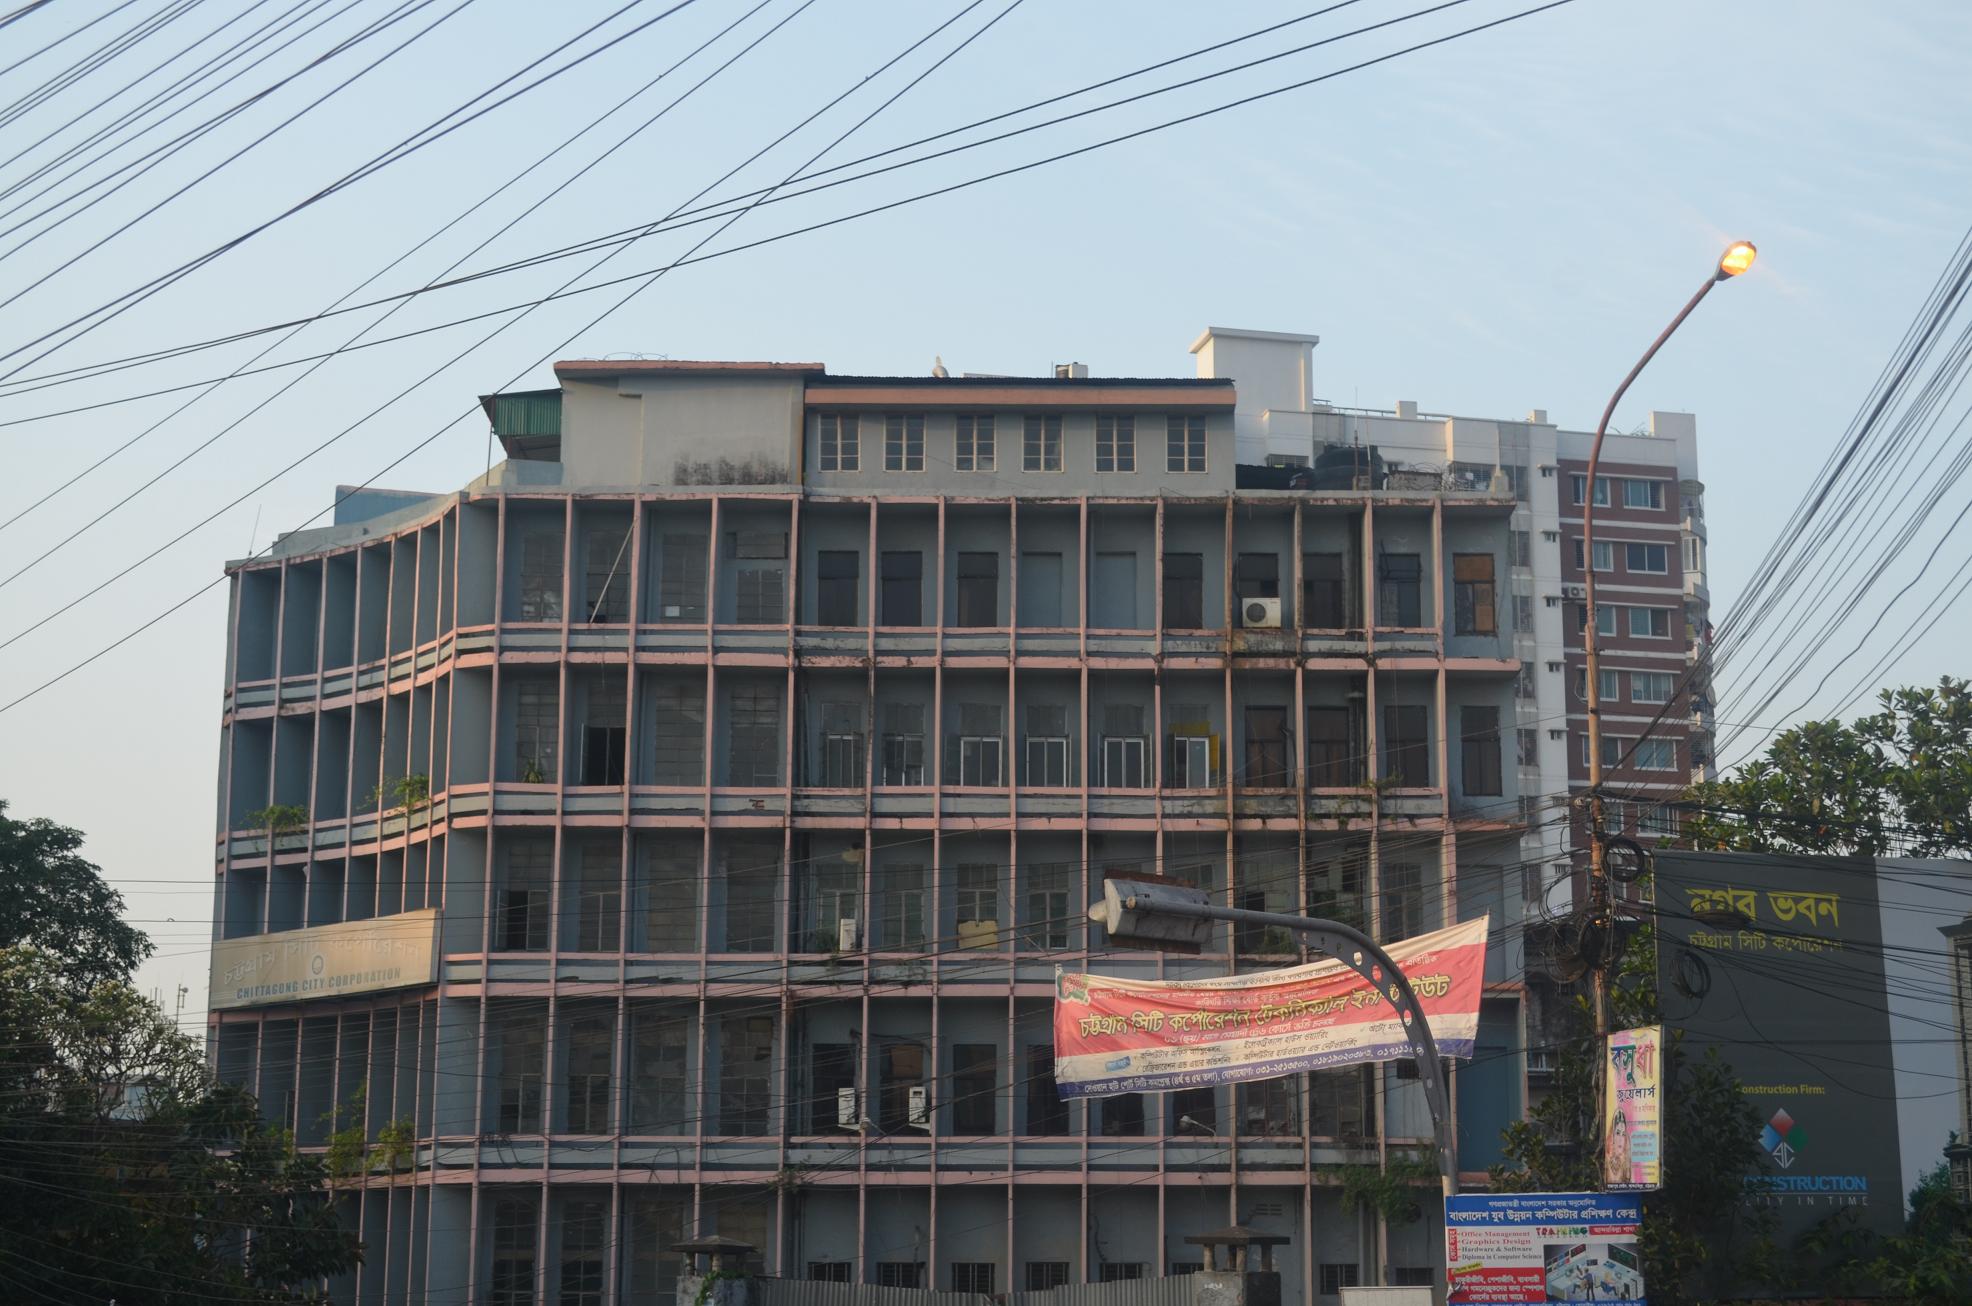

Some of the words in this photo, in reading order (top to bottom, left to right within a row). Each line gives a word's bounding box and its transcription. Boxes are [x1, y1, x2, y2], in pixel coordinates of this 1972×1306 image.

[1767, 891, 1841, 928] ভবন
[1738, 930, 1767, 950] সিটি
[236, 981, 299, 1000] CHITTAGONG
[302, 978, 325, 992] CITY
[1078, 1013, 1128, 1038] চট্টগ্রাম
[1131, 1010, 1166, 1034] সিটি
[1736, 1083, 1798, 1095] onstruction
[1800, 1084, 1825, 1095] Firm:
[1798, 1196, 1814, 1206] IN
[1828, 1196, 1870, 1207] TIME
[1449, 1211, 1489, 1222] বাংলাদেশ
[1491, 1211, 1504, 1223] যুব
[1506, 1208, 1532, 1223] উন্নয়ন
[1534, 1207, 1578, 1221] কম্পিউটার
[1580, 1207, 1613, 1220] প্রশিক্ষণ
[1616, 1208, 1637, 1220] কেন্দ্র
